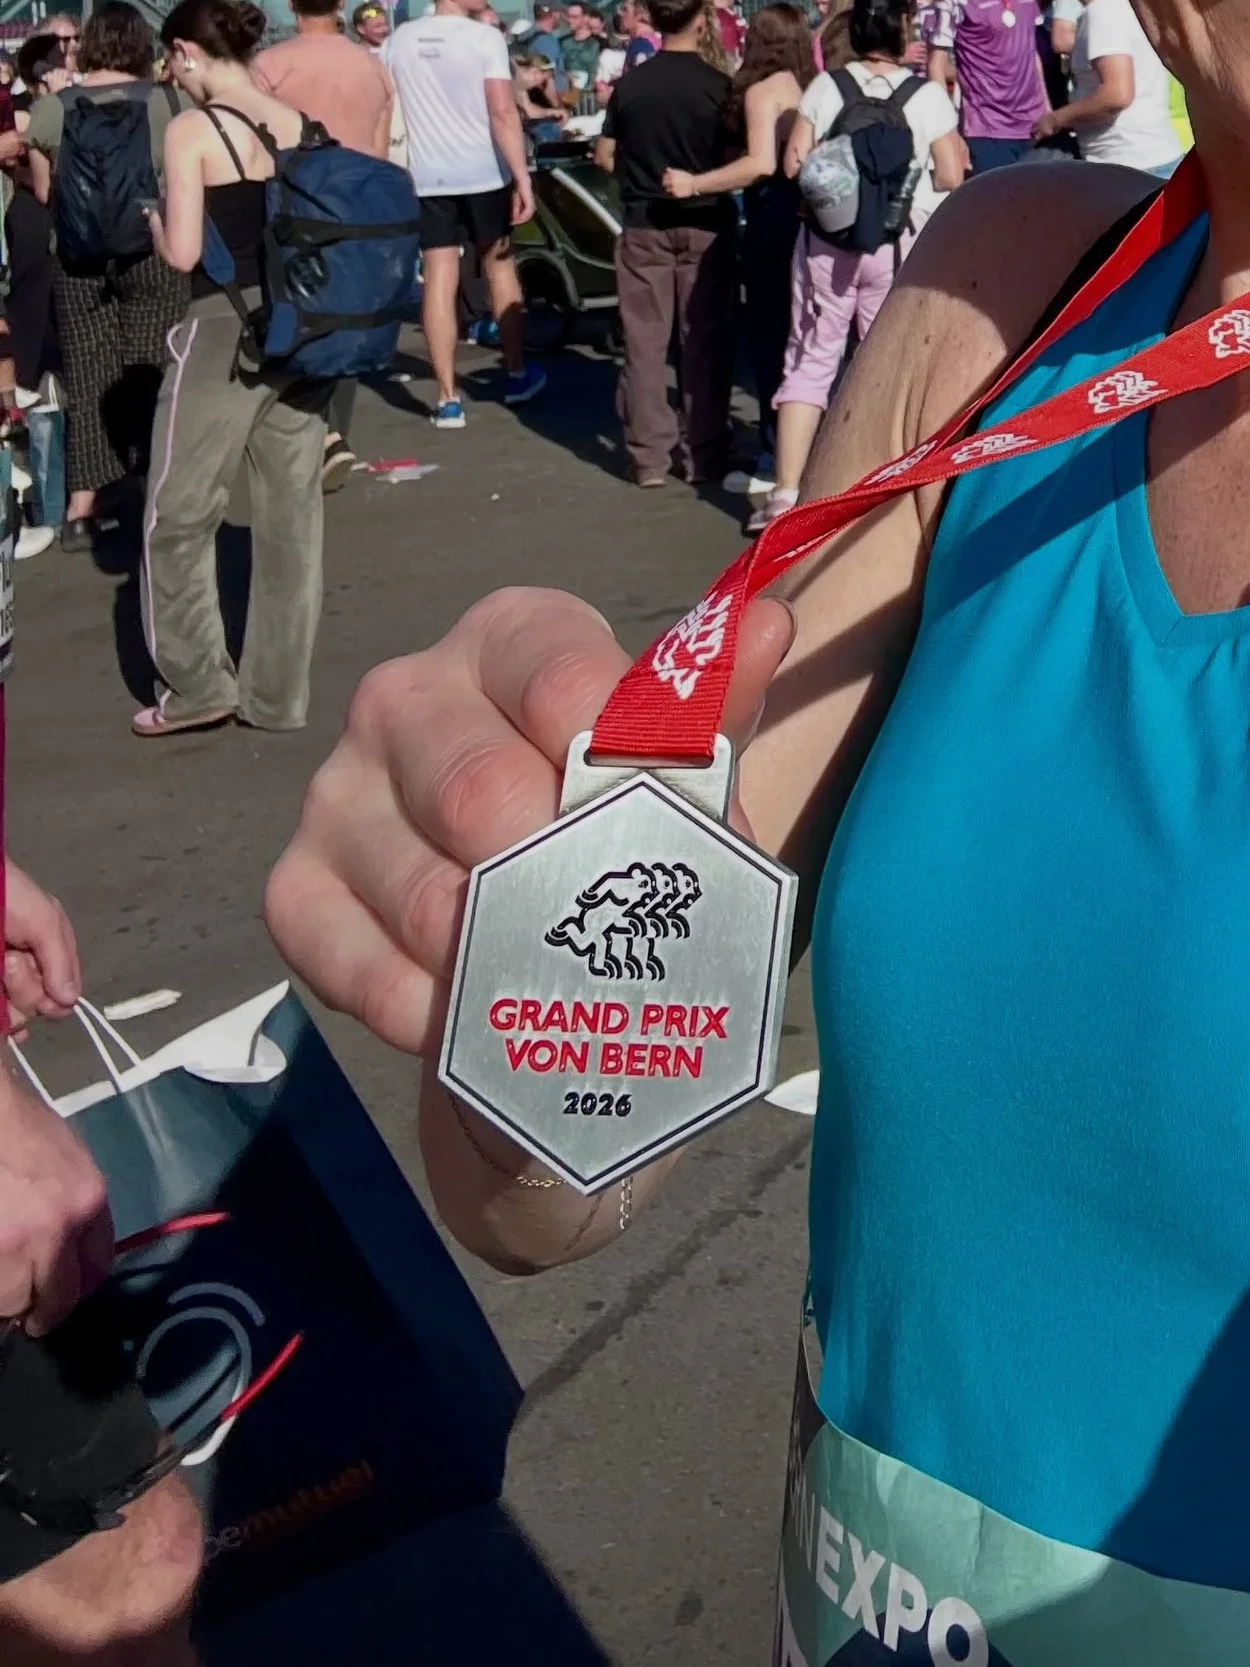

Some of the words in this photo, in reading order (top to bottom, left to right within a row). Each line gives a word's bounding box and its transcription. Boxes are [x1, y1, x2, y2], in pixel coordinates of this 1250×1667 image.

[488, 998, 630, 1036] GRAND
[640, 1003, 730, 1040] PRIX
[504, 1038, 590, 1074] VON
[599, 1042, 704, 1078] BERN
[562, 1091, 633, 1117] 2026
